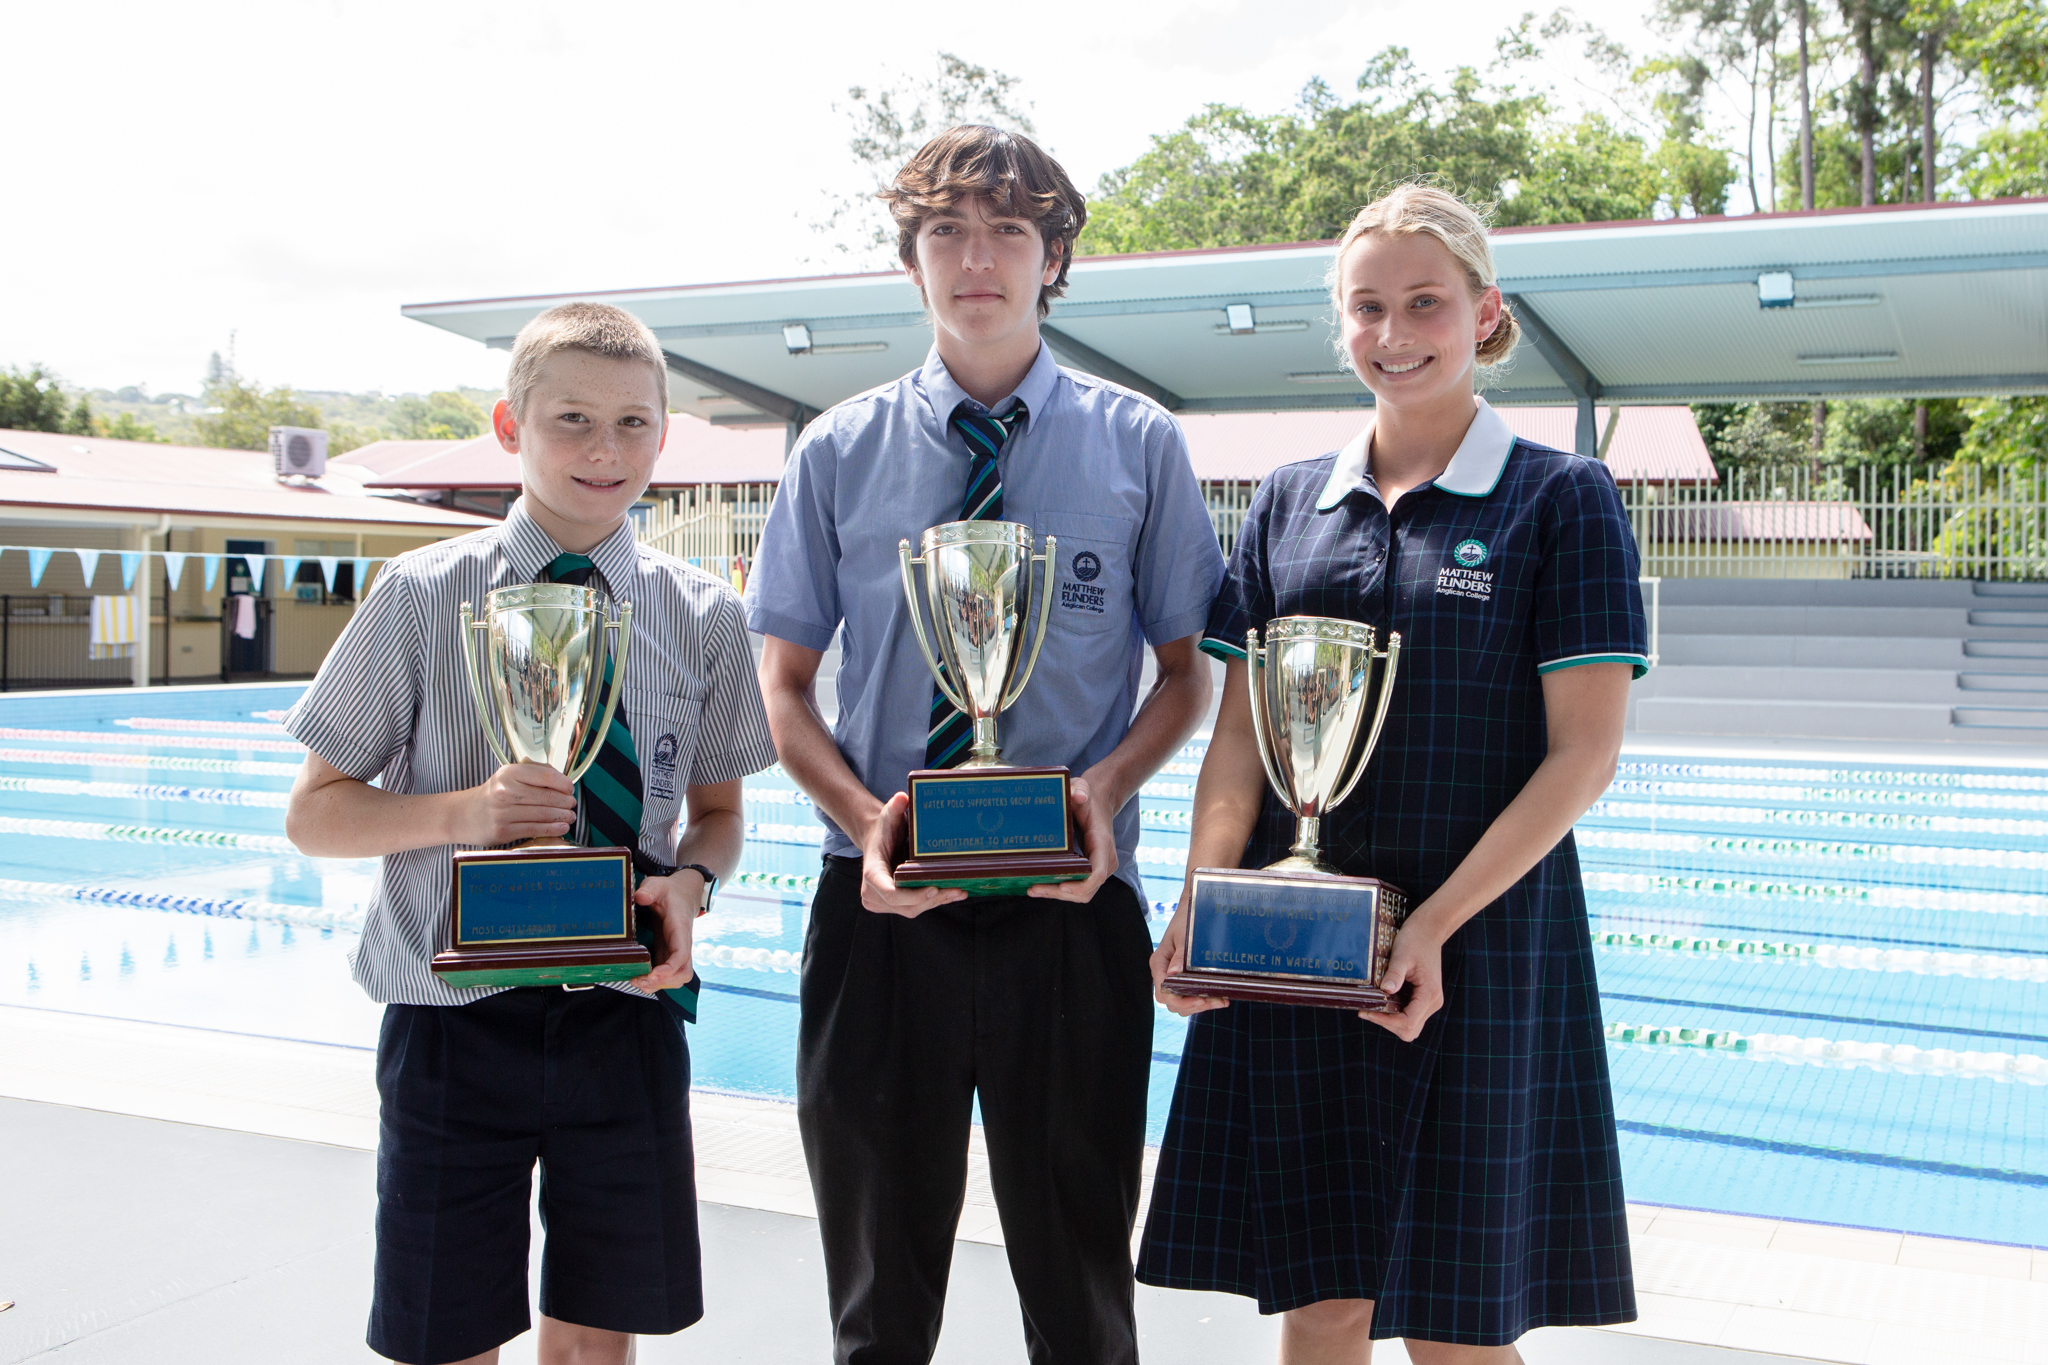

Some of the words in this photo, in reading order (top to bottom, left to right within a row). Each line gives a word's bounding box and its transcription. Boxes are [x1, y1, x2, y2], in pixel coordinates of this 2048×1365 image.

[1439, 567, 1494, 582] MATTHEW
[1062, 582, 1106, 596] MATTHEW
[1437, 576, 1492, 594] FLINDERS
[1062, 591, 1104, 607] FLINDERS
[1436, 587, 1464, 597] Anglican
[1465, 590, 1491, 602] College
[1061, 601, 1085, 610] Anglican
[1086, 605, 1105, 614] College
[651, 768, 674, 780] MATTHEW
[651, 777, 673, 790] FLINDERS
[923, 799, 944, 809] WATER
[947, 799, 964, 809] POLO
[967, 797, 1008, 808] SUPPORTERS
[1010, 796, 1032, 806] GROUP
[1034, 795, 1056, 805] AWARD
[988, 836, 999, 845] TO
[1002, 835, 1030, 845] WATER
[489, 884, 503, 893] OF
[509, 881, 543, 892] WATER
[549, 881, 576, 891] POLO
[581, 879, 616, 889] AWARD
[1205, 887, 1244, 900] MATTHEW
[1247, 890, 1284, 903] FLINDERS
[1286, 893, 1324, 906] ANGLICAN
[1326, 896, 1362, 908] COLLEGE
[1214, 903, 1274, 918] ROBINSON
[1280, 908, 1321, 921] FAMILY
[1328, 911, 1351, 923] CUP
[471, 925, 495, 935] MOST
[1271, 954, 1281, 966] IN
[1286, 956, 1321, 969] WATER
